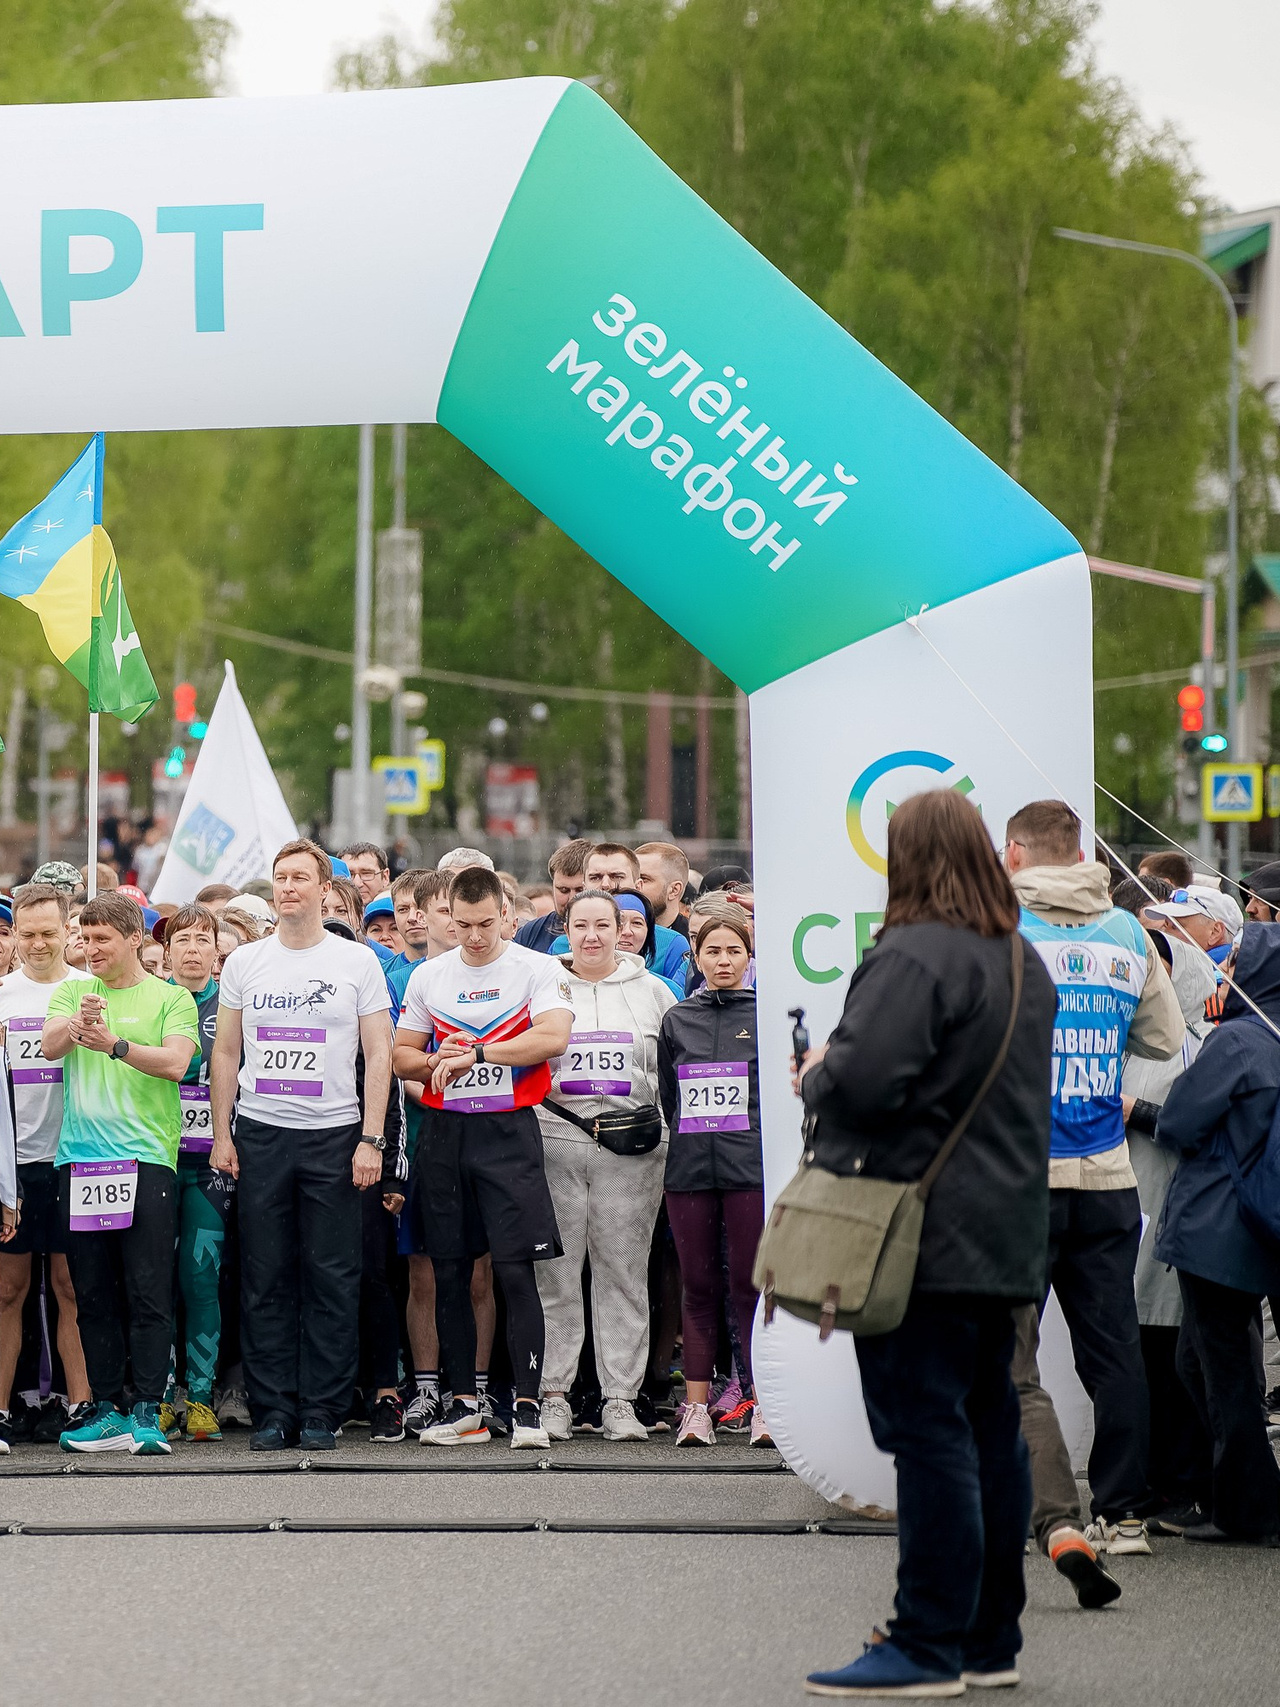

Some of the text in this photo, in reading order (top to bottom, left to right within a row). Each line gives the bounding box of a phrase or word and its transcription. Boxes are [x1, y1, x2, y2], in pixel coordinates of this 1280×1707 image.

[591, 292, 859, 527] зелёный
[545, 338, 802, 573] марафон
[253, 993, 302, 1010] Utair
[1093, 993, 1118, 1014] ЮГРА
[20, 1040, 45, 1059] 22
[1052, 1024, 1119, 1055] АВНЫЙ
[263, 1050, 317, 1071] 2072
[570, 1051, 625, 1071] 2153
[688, 1086, 740, 1107] 2152
[180, 1109, 210, 1128] 93
[82, 1183, 131, 1205] 2185
